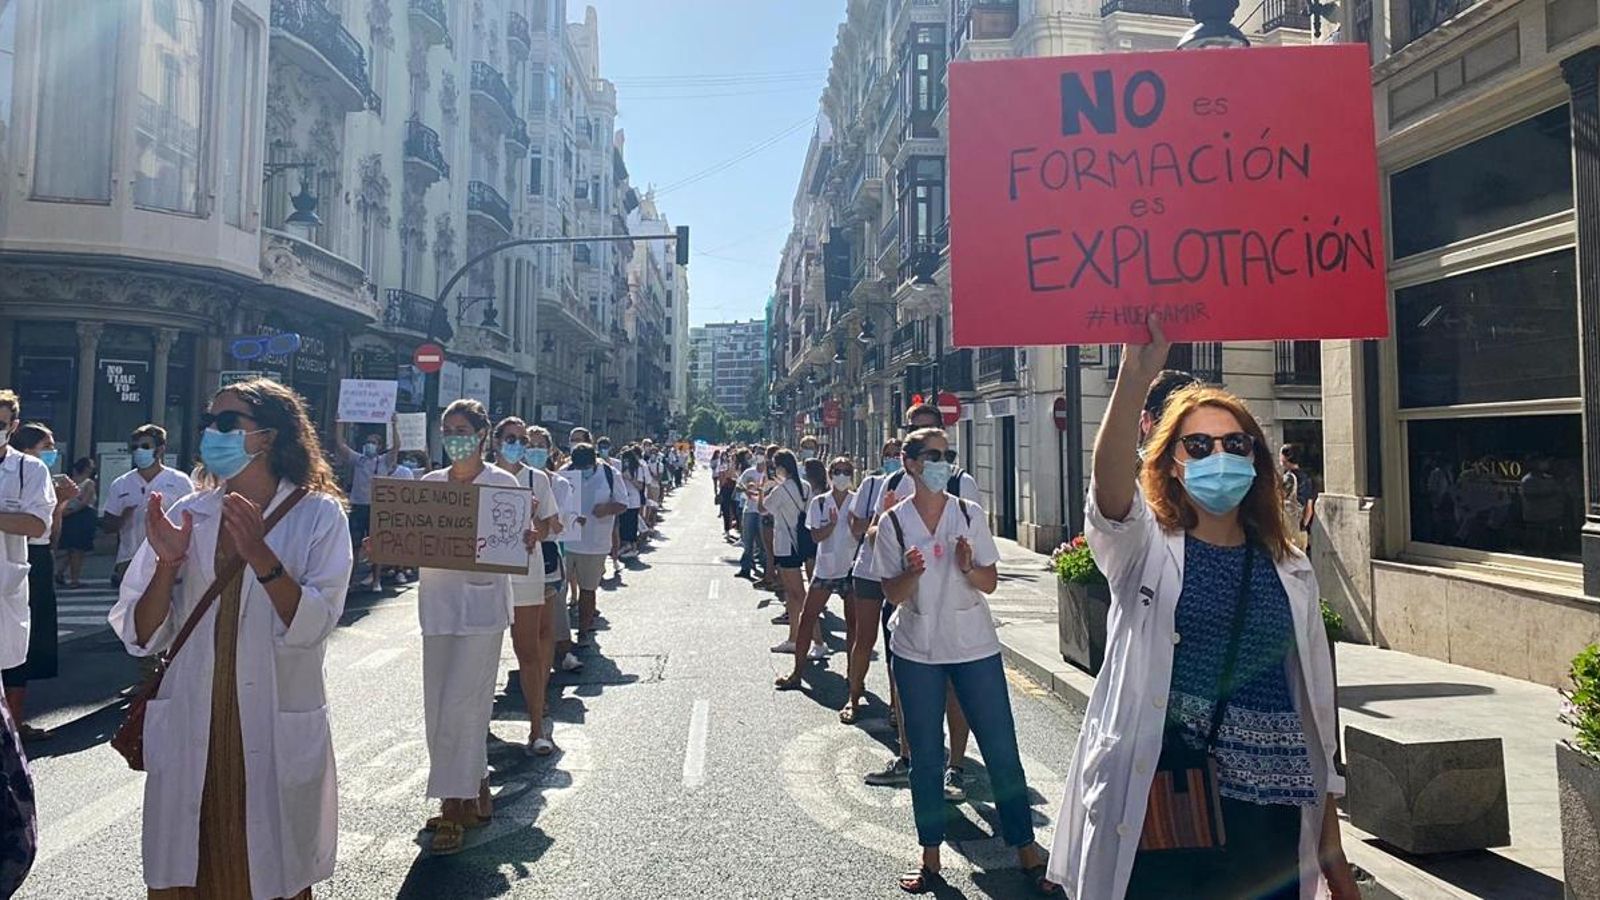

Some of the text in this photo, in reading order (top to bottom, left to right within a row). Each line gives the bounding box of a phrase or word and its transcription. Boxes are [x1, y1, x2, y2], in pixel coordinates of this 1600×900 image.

[1059, 69, 1229, 135] NO es
[1130, 195, 1166, 218] es
[107, 365, 123, 376] NO
[108, 374, 136, 384] TIME
[114, 383, 130, 393] TO
[121, 392, 140, 402] DIE
[375, 485, 471, 507] ES QUE NADIE
[437, 514, 455, 528] EN
[455, 515, 474, 530] LOS
